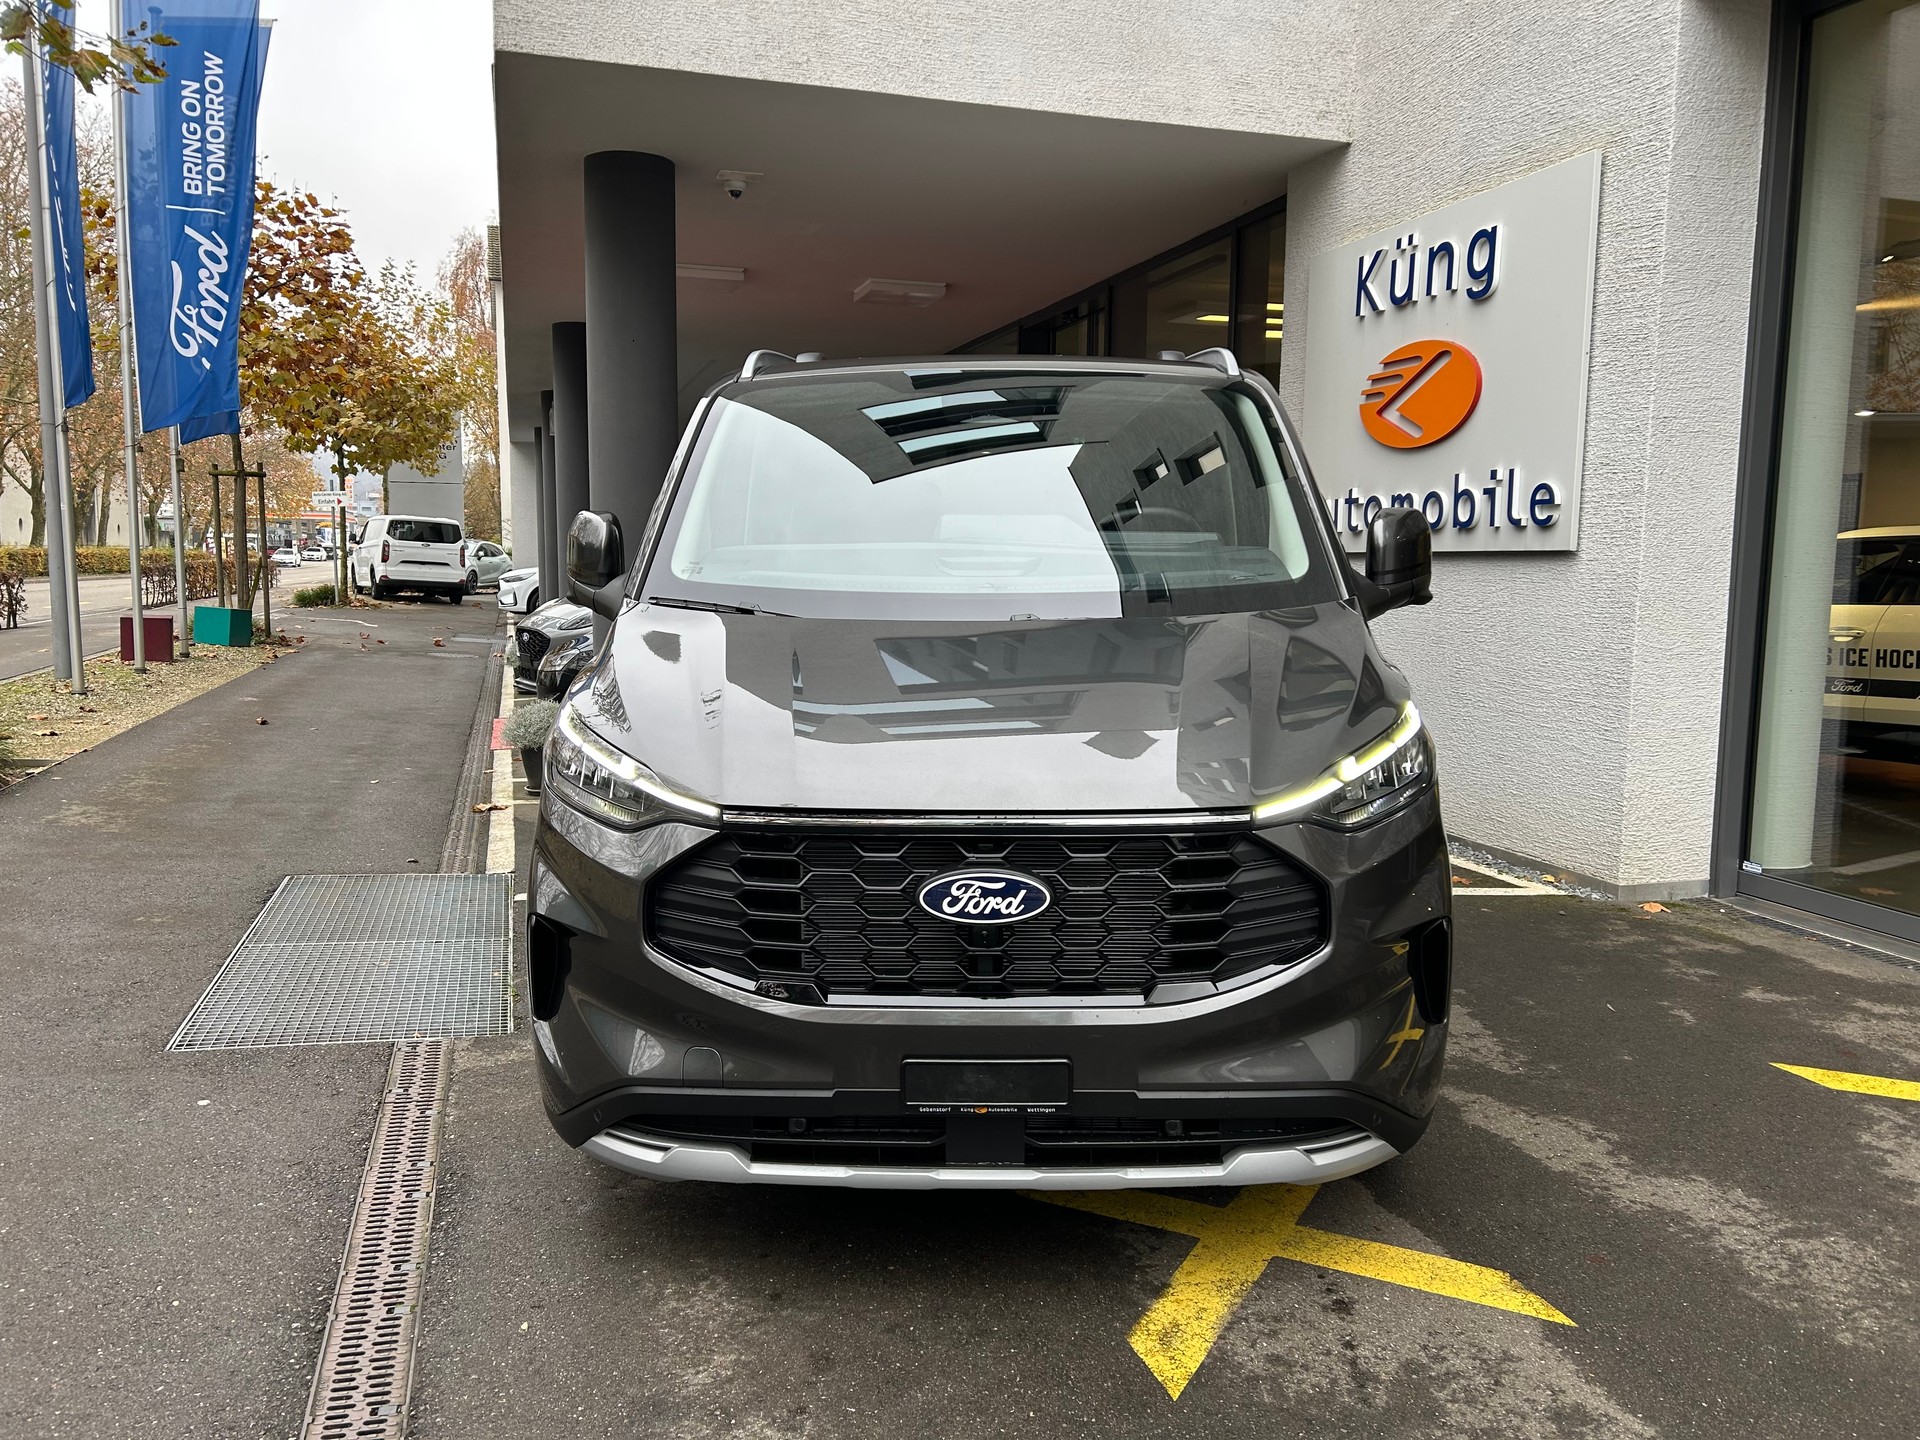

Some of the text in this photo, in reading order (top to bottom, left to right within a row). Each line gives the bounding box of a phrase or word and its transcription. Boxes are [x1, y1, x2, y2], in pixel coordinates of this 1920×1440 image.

[180, 79, 202, 195] BRING ON
[203, 50, 226, 196] TOMORROW
[170, 224, 229, 370] Ford
[1355, 223, 1500, 317] Küng
[1330, 467, 1561, 534] utomobile
[1830, 678, 1864, 693] Ford
[1839, 647, 1869, 667] ICE
[942, 880, 1027, 915] Ford
